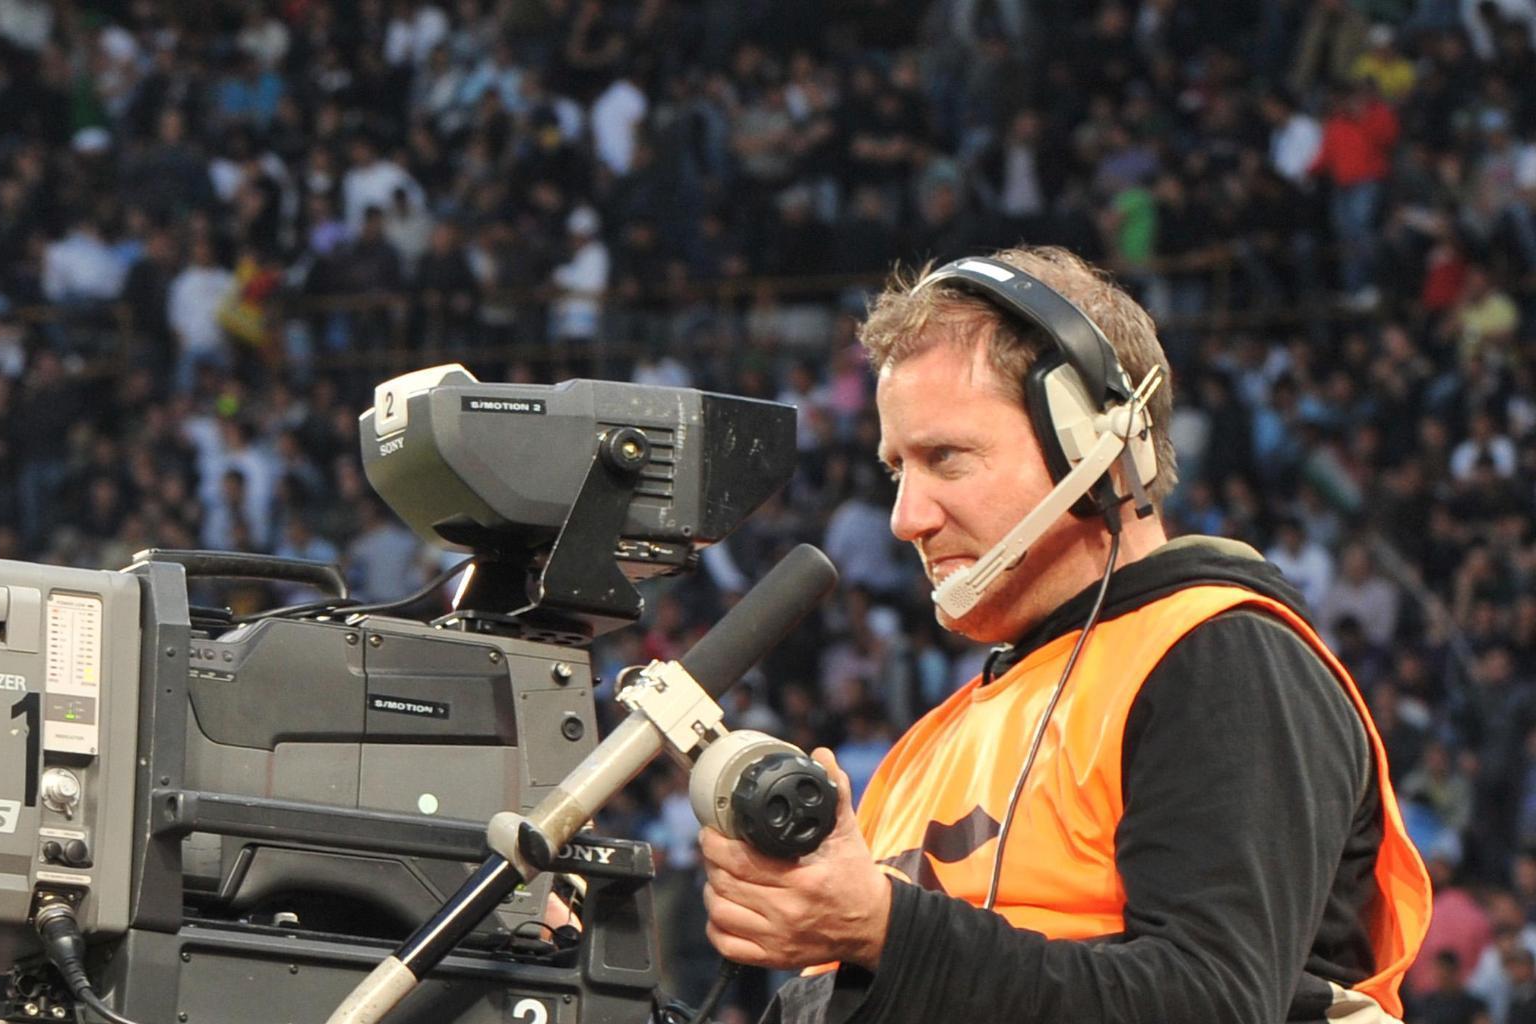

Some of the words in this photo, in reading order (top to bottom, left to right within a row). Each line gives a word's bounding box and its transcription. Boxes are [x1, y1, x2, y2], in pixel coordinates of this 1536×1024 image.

[385, 391, 395, 418] 2
[532, 403, 542, 412] 2
[379, 436, 405, 457] SONY
[11, 692, 40, 807] 1
[558, 844, 616, 864] ONY
